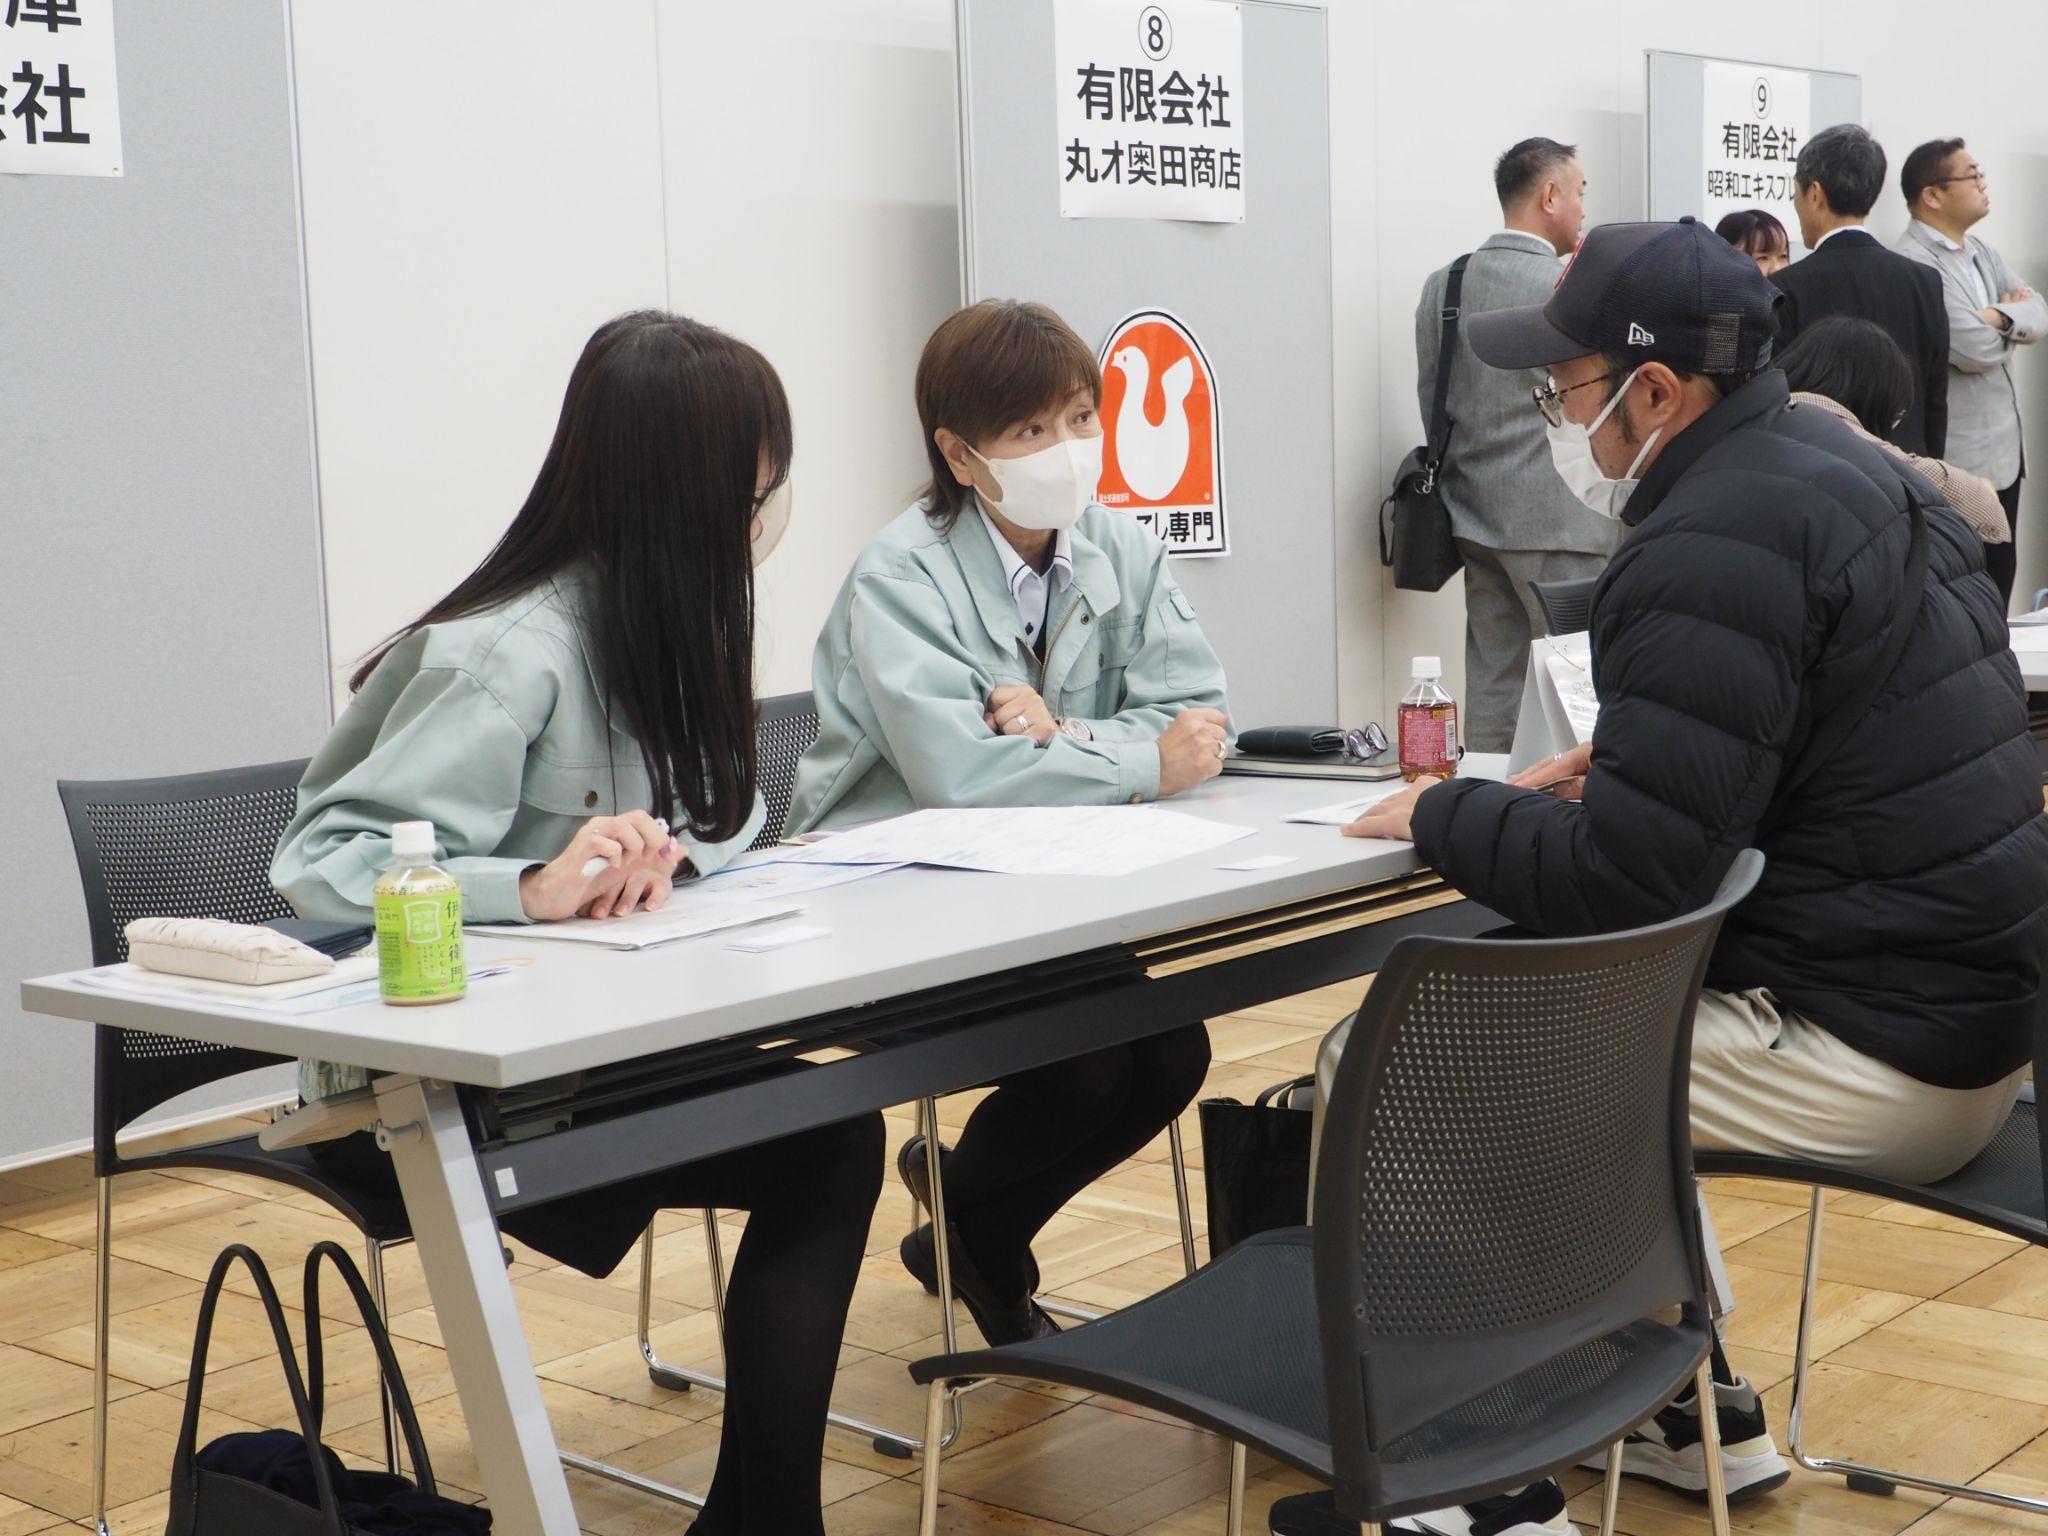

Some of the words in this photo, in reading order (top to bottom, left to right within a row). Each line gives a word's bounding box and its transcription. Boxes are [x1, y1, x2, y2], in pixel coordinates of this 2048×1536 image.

[0, 61, 90, 144] 社
[1077, 63, 1231, 128] 有限会社
[1722, 121, 1797, 162] 有限会社
